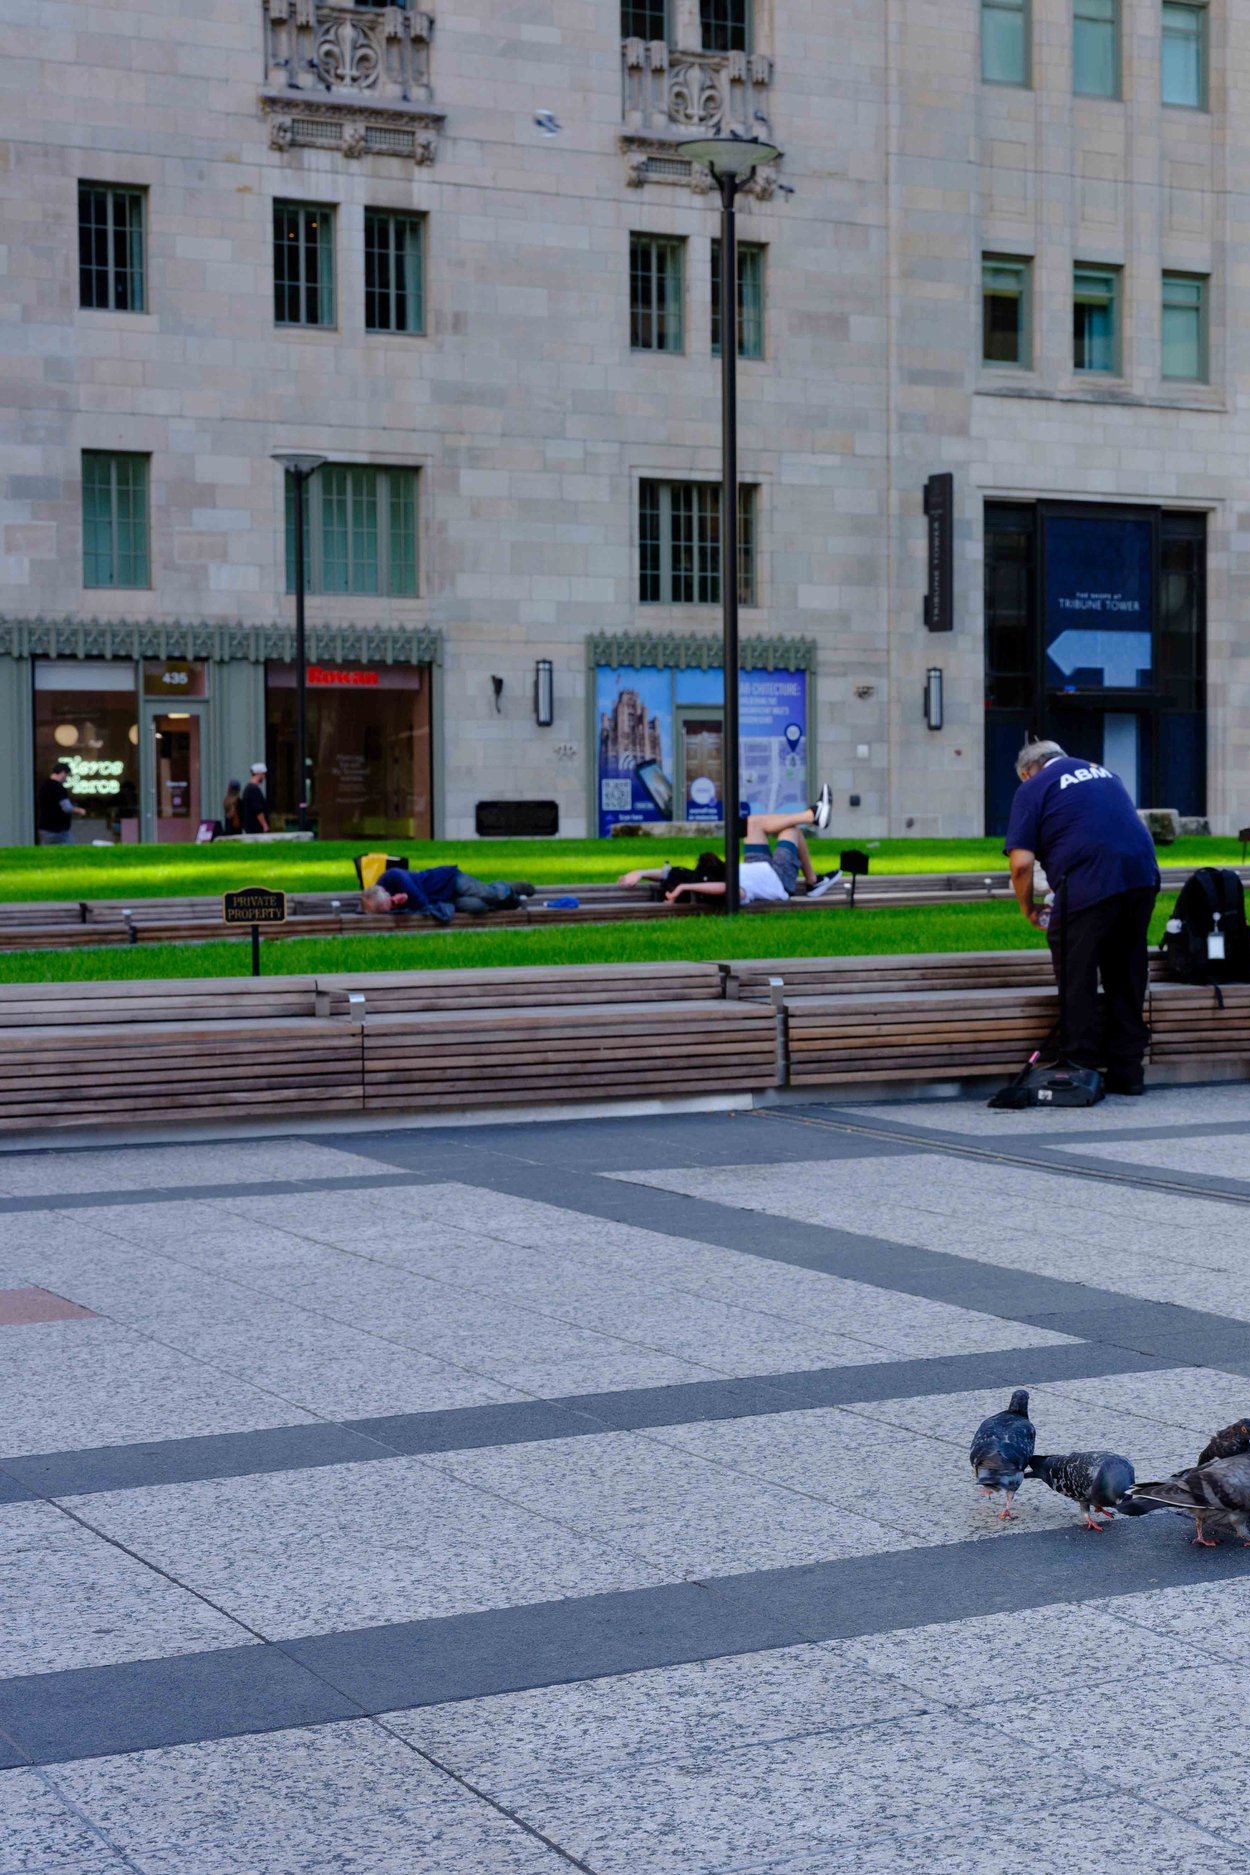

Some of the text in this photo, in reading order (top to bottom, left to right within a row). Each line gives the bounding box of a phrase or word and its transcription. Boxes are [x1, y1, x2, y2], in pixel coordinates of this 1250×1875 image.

[932, 521, 940, 623] TRIBUNE TOWER
[1058, 598, 1140, 612] TRIBUNE TOWER
[162, 672, 188, 684] 435
[306, 666, 379, 685] Rowan
[1060, 767, 1113, 790] ABM
[233, 896, 276, 907] PRIVATE
[228, 908, 282, 919] PROPERTY
